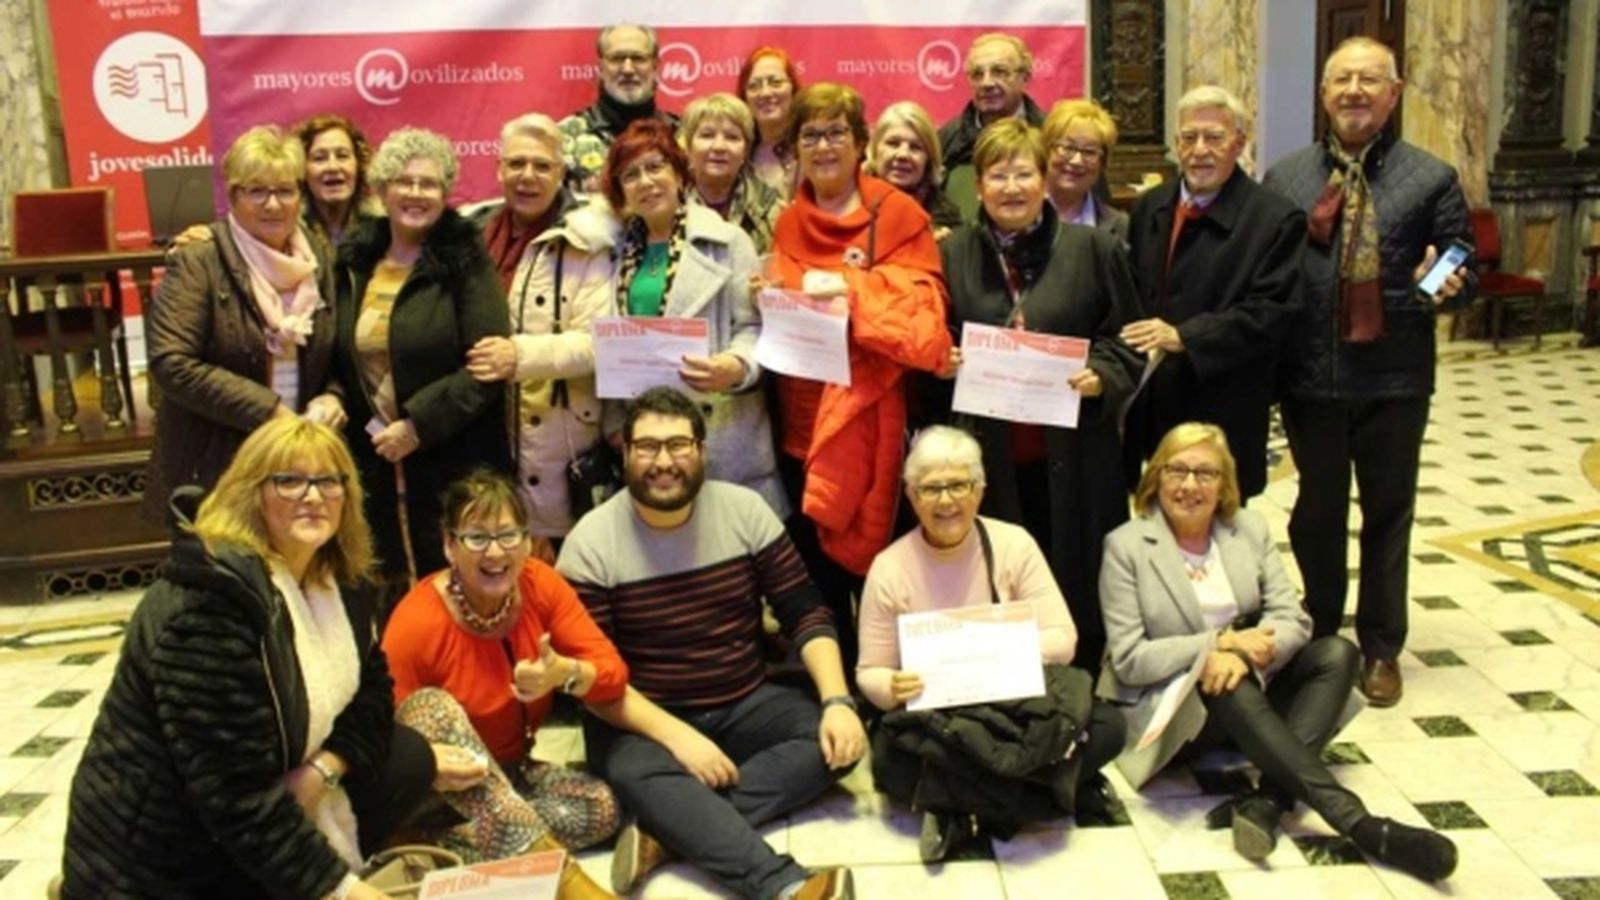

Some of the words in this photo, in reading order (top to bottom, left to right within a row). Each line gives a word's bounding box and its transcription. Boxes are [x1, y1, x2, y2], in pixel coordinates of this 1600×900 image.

[252, 70, 353, 94] mayores
[410, 62, 524, 84] ovilizados
[836, 59, 915, 79] mayores
[453, 139, 502, 157] ores
